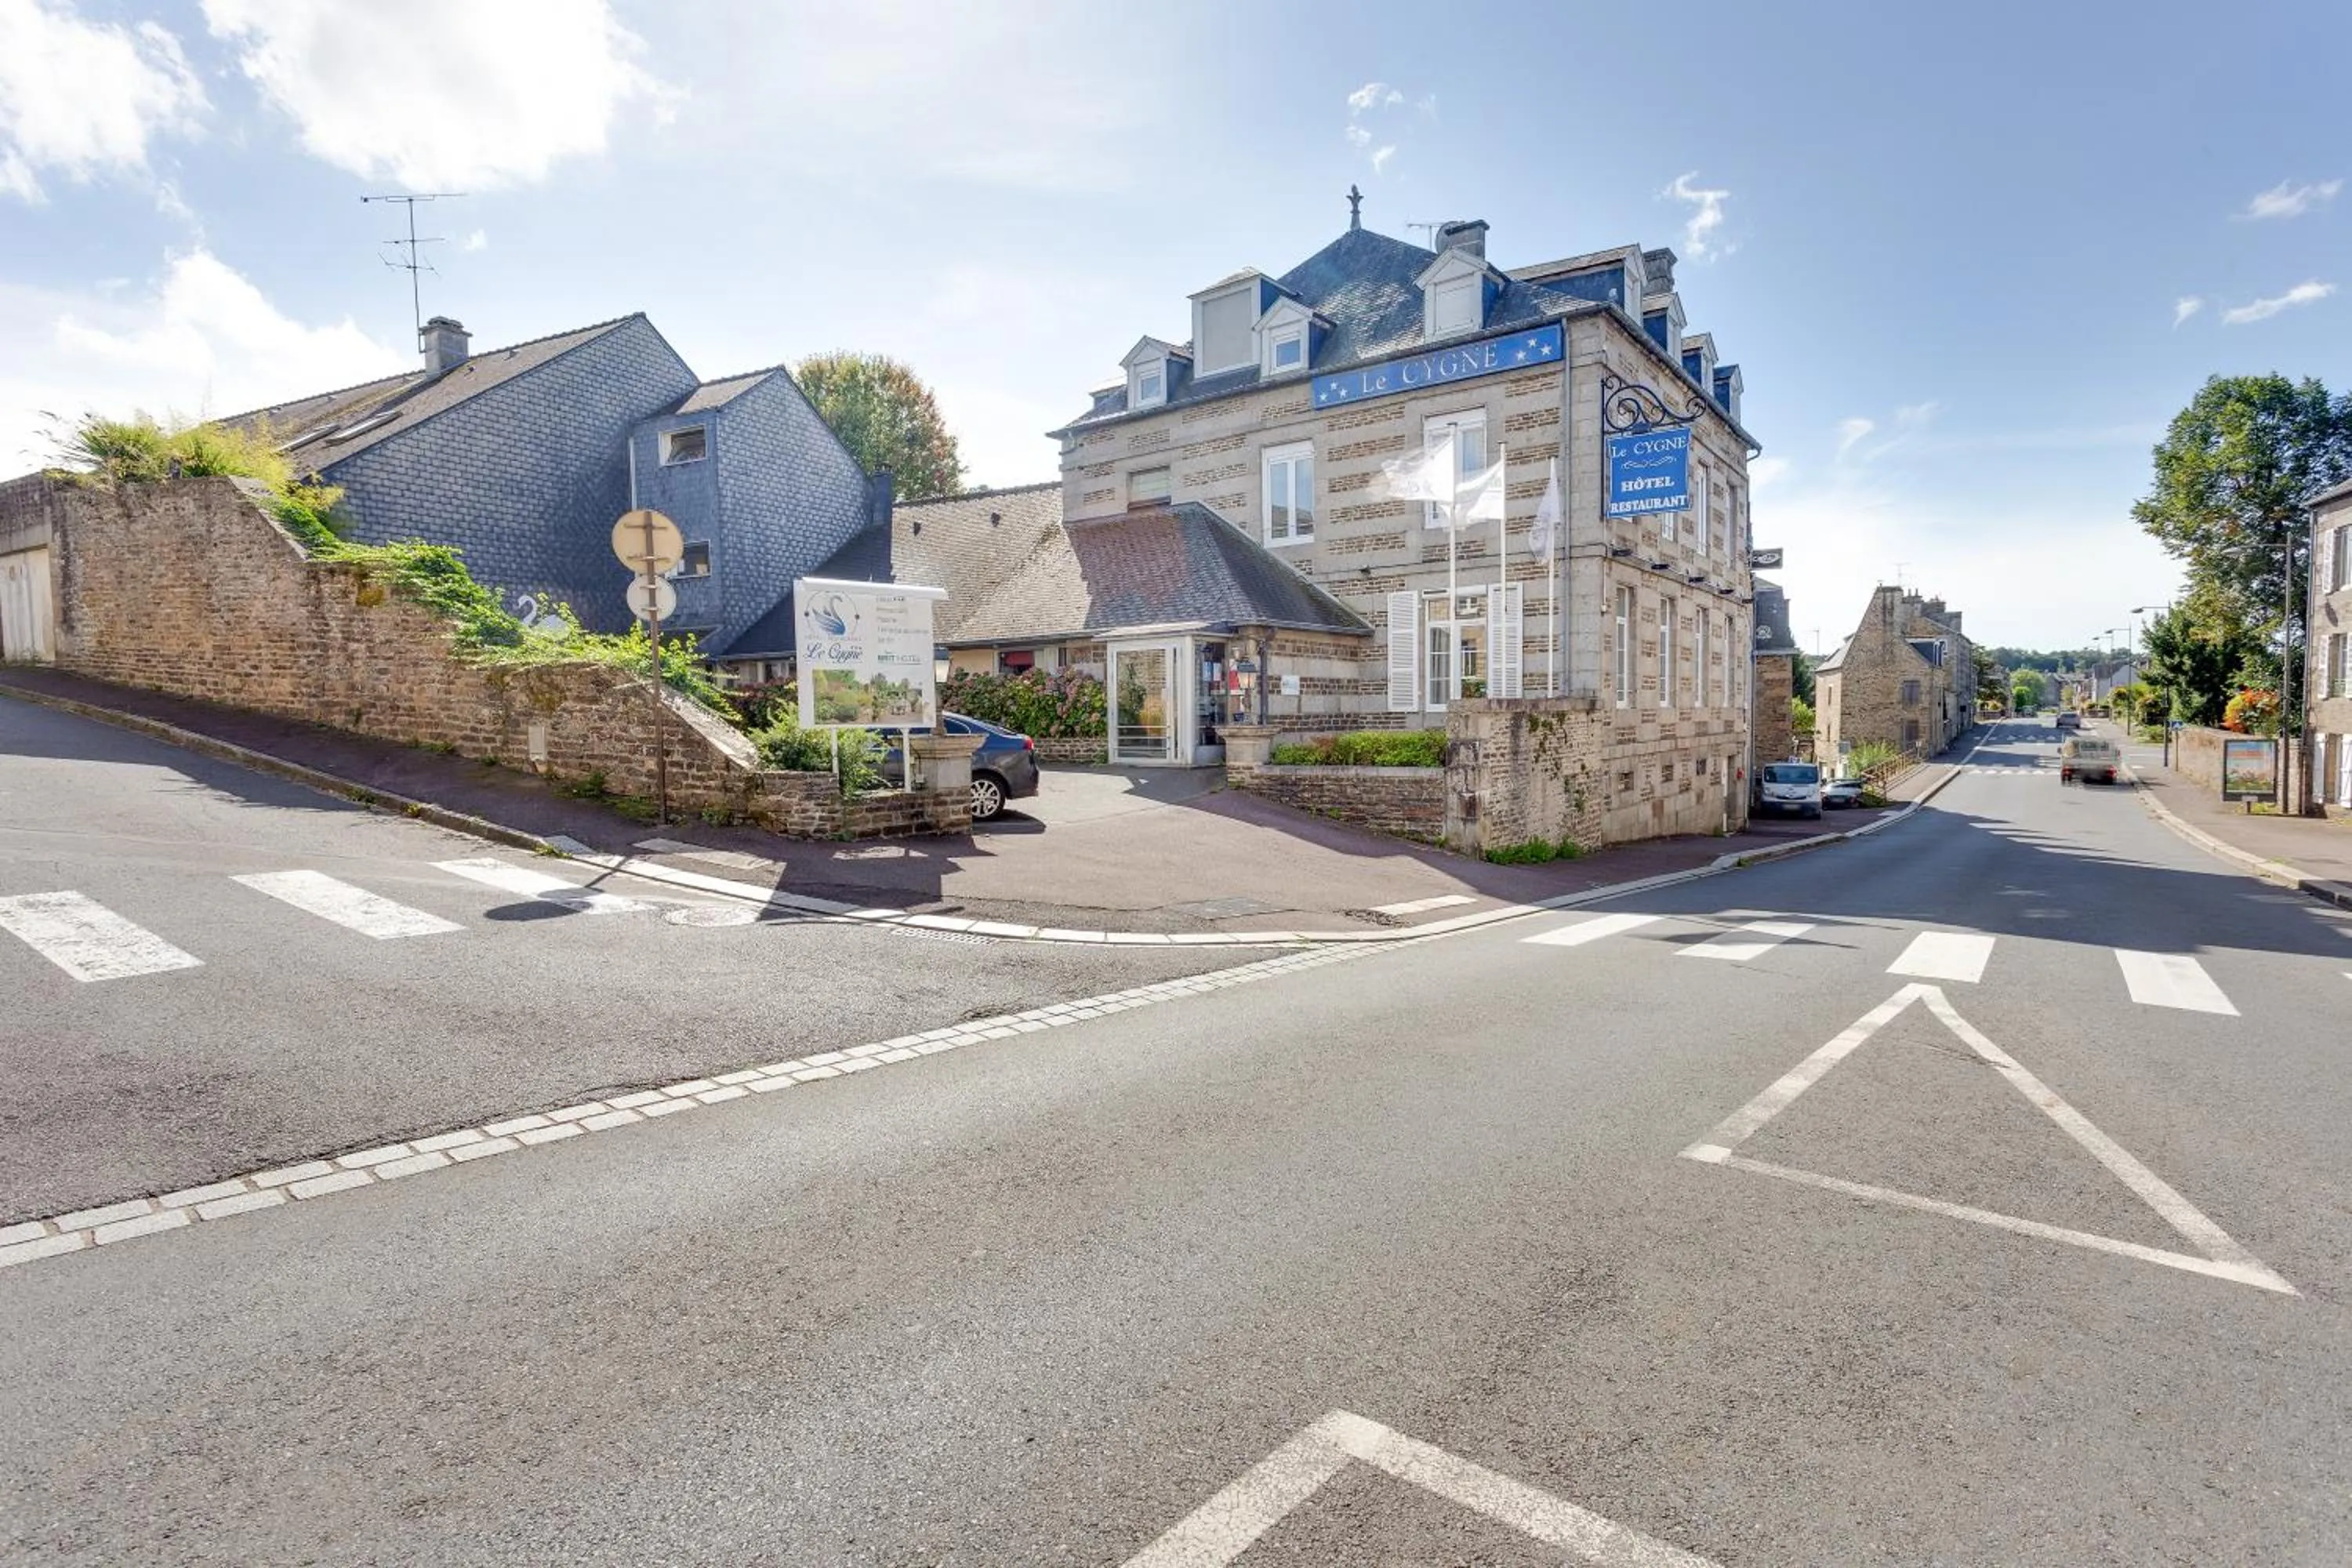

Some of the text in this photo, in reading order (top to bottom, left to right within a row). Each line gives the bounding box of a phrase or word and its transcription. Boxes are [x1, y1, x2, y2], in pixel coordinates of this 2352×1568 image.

[1362, 343, 1498, 394] Le CYGNE
[1612, 436, 1686, 458] Le CYGNE
[1621, 476, 1675, 492] HÔTEL
[1610, 495, 1687, 514] RESTAURANT
